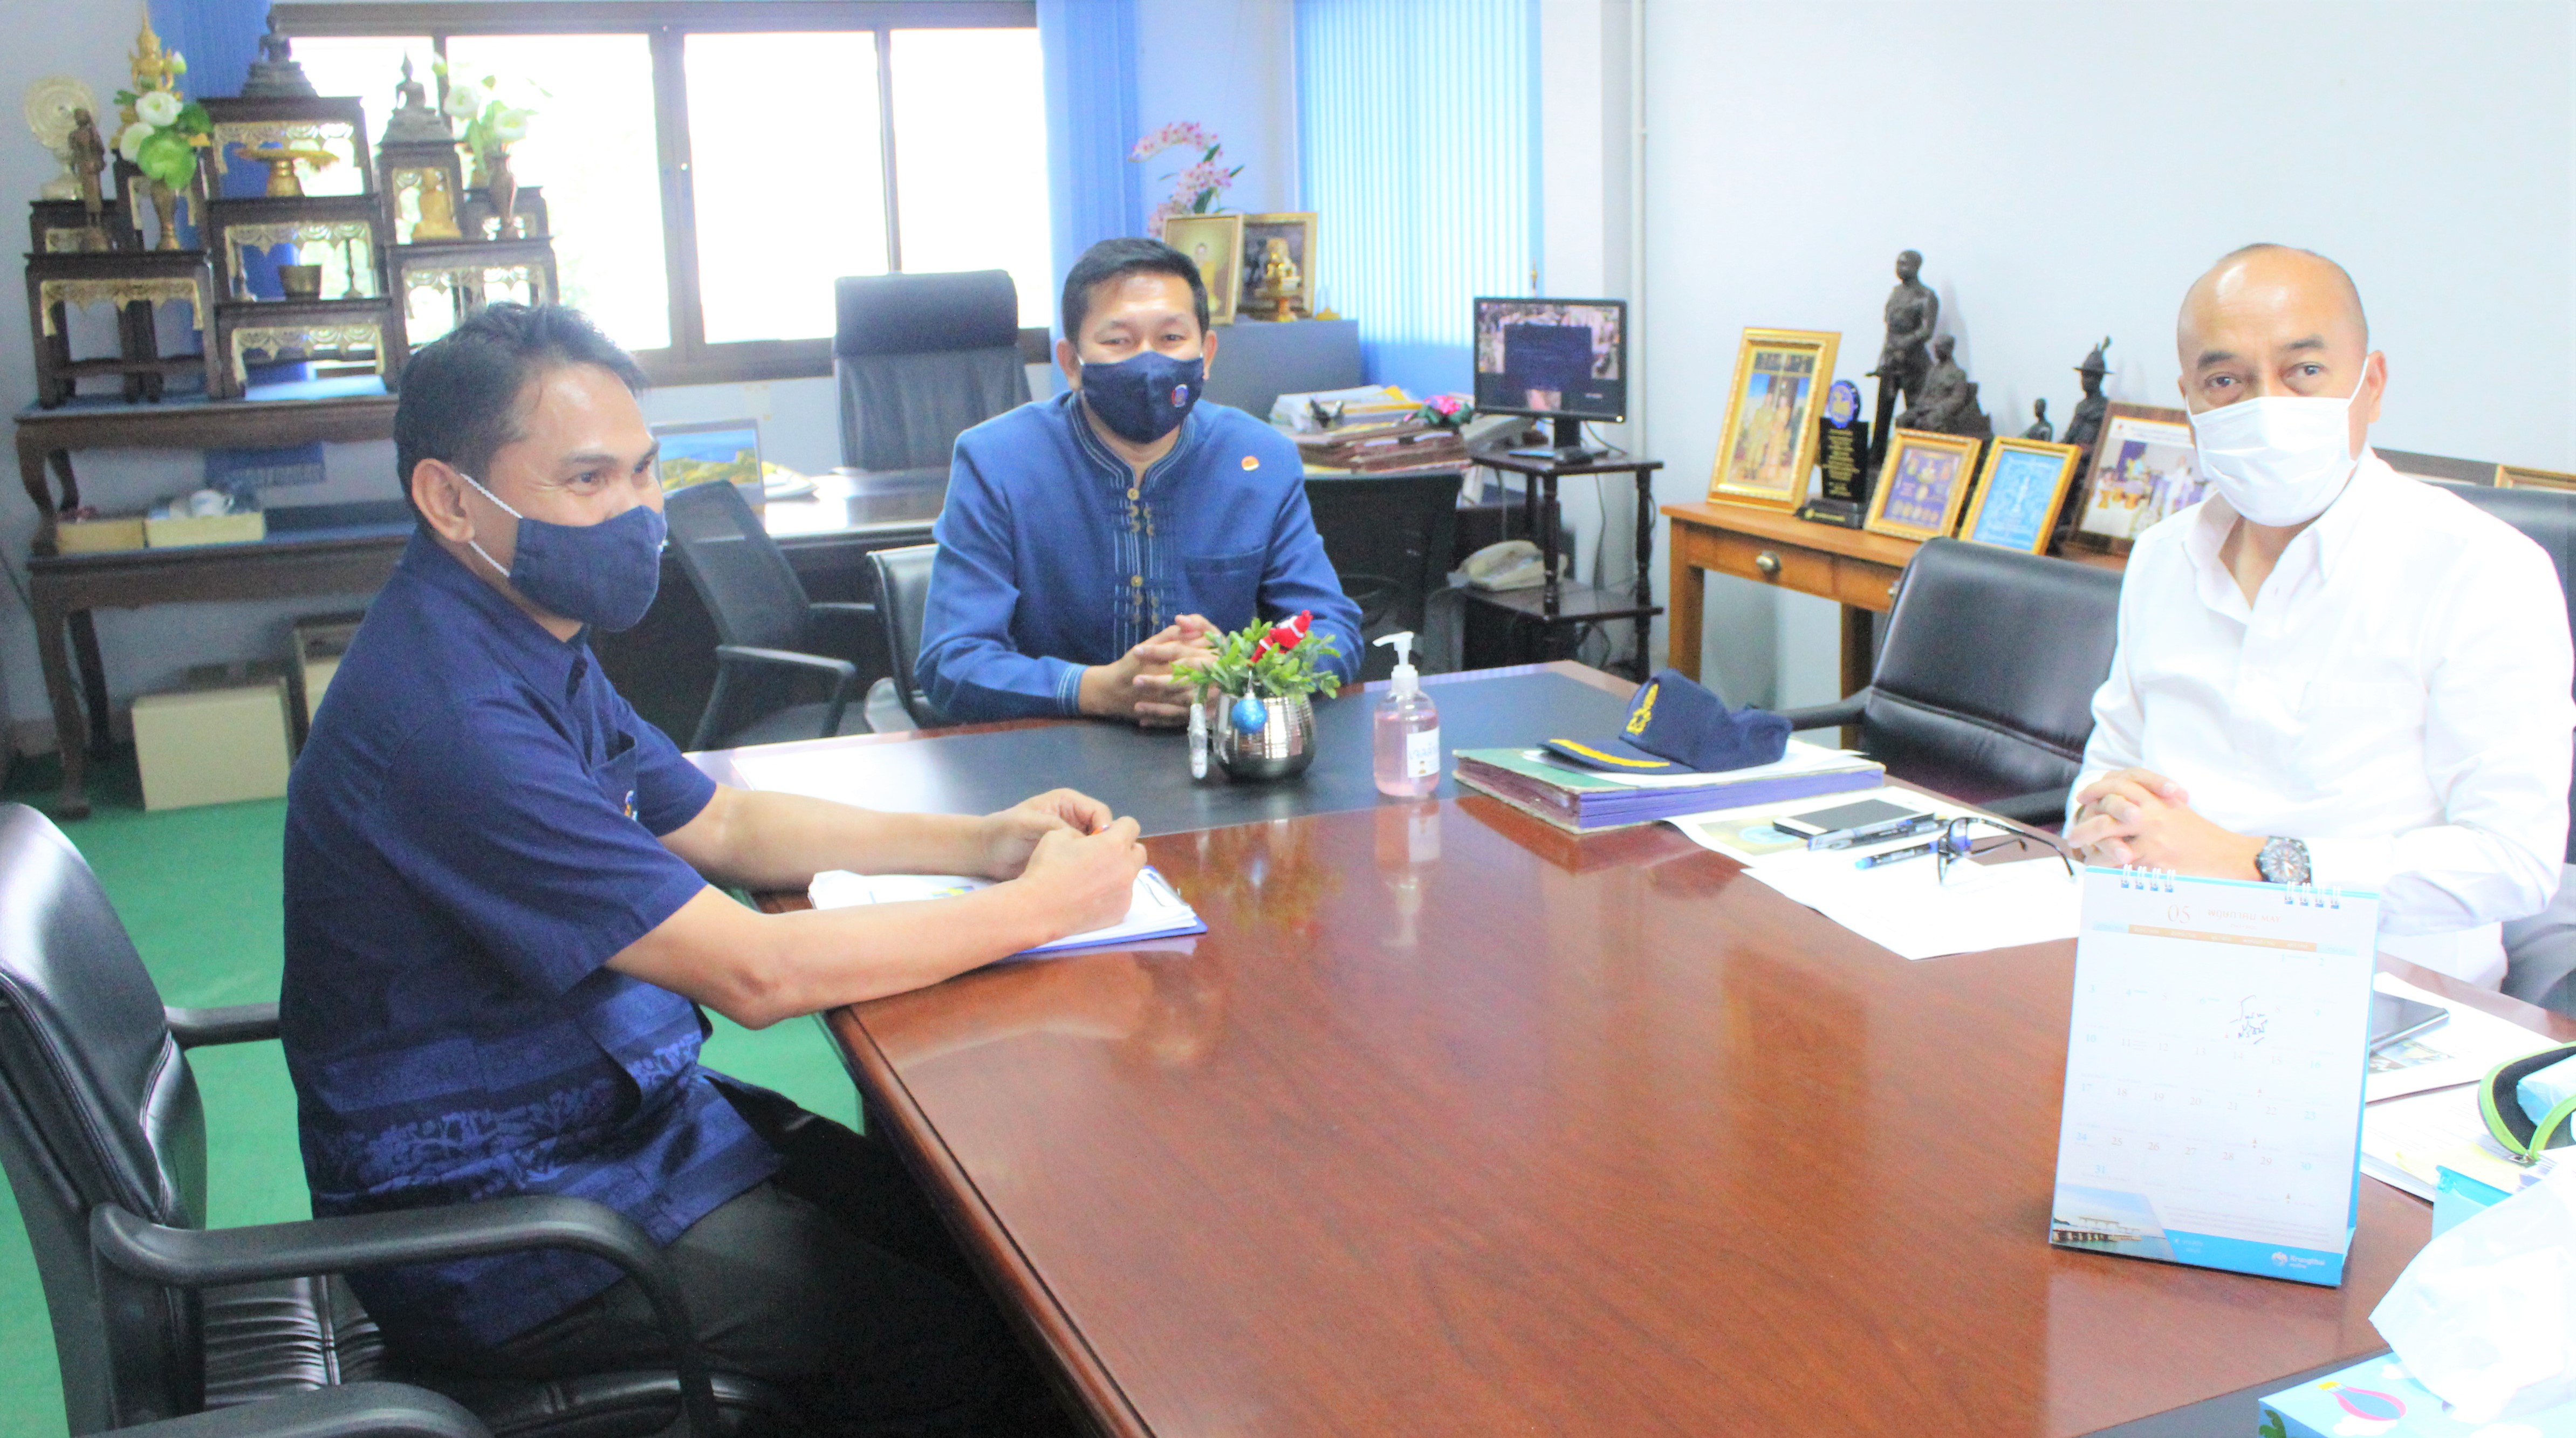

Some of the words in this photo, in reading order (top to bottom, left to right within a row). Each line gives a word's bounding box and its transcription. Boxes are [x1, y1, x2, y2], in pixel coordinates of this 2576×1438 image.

[2167, 905, 2190, 924] 05
[2208, 909, 2256, 920] พฤษภาคม
[2260, 915, 2281, 923] MAY
[2282, 953, 2285, 962] 1
[2318, 958, 2325, 967] 2
[2089, 984, 2095, 993] 3
[2126, 989, 2132, 997] 4
[2162, 992, 2167, 1001] 5
[2200, 997, 2207, 1005] 6
[2275, 1005, 2280, 1014] 8
[2313, 1009, 2321, 1017] 9
[2086, 1034, 2097, 1043] 10
[2122, 1038, 2131, 1047] 11
[2158, 1043, 2168, 1051] 12
[2195, 1047, 2205, 1056] 13
[2233, 1051, 2243, 1060] 14
[2271, 1056, 2282, 1065] 15
[2310, 1060, 2321, 1069] 16
[2081, 1083, 2092, 1092] 17
[2117, 1087, 2127, 1097] 18
[2154, 1092, 2164, 1101] 19
[2190, 1097, 2201, 1105] 20
[2228, 1101, 2238, 1110] 21
[2265, 1106, 2277, 1115] 22
[2304, 1111, 2316, 1120] 23
[2077, 1132, 2087, 1141] 24
[2111, 1137, 2122, 1146] 25
[2148, 1142, 2159, 1151] 26
[2184, 1146, 2196, 1156] 27
[2222, 1152, 2234, 1161] 28
[2260, 1156, 2272, 1166] 29
[2300, 1161, 2312, 1171] 30
[2095, 1165, 2106, 1174] 31
